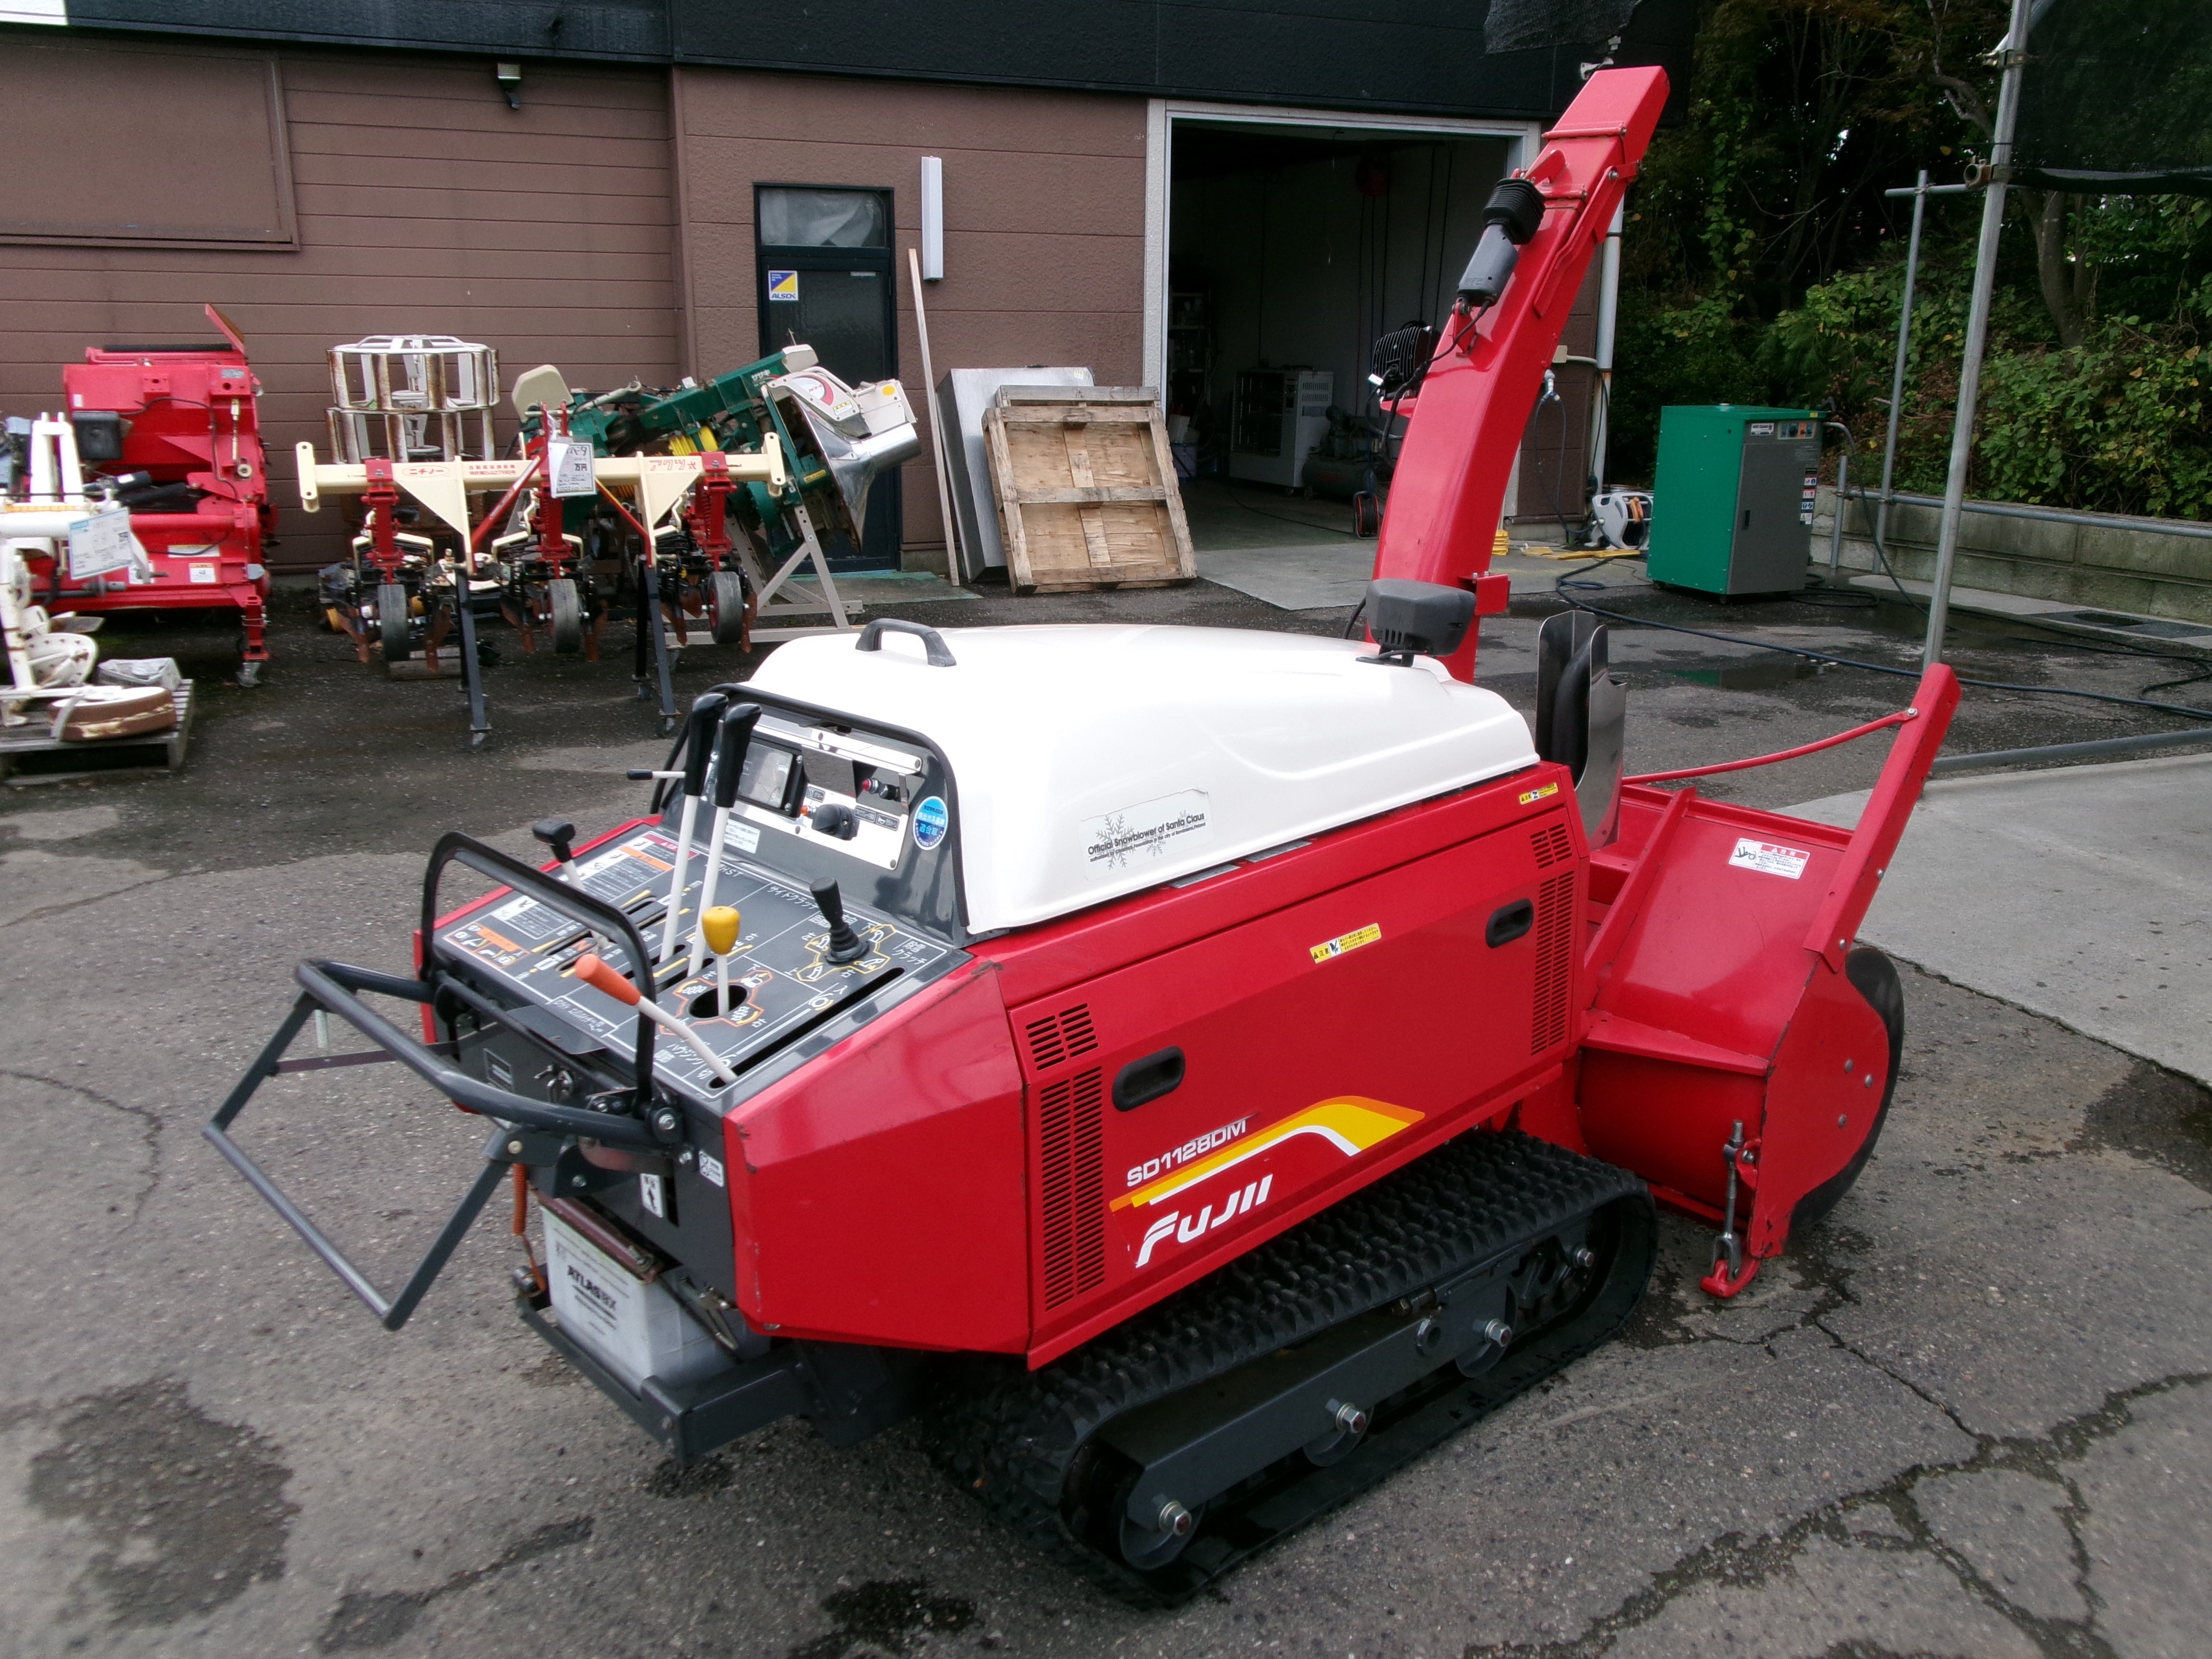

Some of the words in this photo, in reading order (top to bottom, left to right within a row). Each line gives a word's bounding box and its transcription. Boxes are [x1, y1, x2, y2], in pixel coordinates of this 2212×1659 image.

[649, 459, 697, 471] アクツ式
[919, 823, 938, 836] 適合車
[1088, 840, 1113, 854] Official
[1114, 828, 1156, 847] Snowblower
[1158, 823, 1165, 833] of
[1166, 818, 1185, 830] Santa
[1186, 813, 1204, 824] Claus
[767, 885, 819, 909] サイドクラッチ
[861, 922, 875, 930] 下
[745, 932, 758, 942] 右
[802, 932, 816, 941] 左
[902, 940, 927, 953] 除雪
[891, 949, 927, 965] クラッチ
[702, 971, 717, 980] 左
[783, 967, 799, 976] 上
[840, 969, 856, 979] 右
[833, 984, 848, 995] 入
[751, 1018, 767, 1029] 右
[697, 1069, 713, 1080] 切
[1127, 1118, 1247, 1187] SD1128DM
[1134, 1174, 1274, 1269] FUJII
